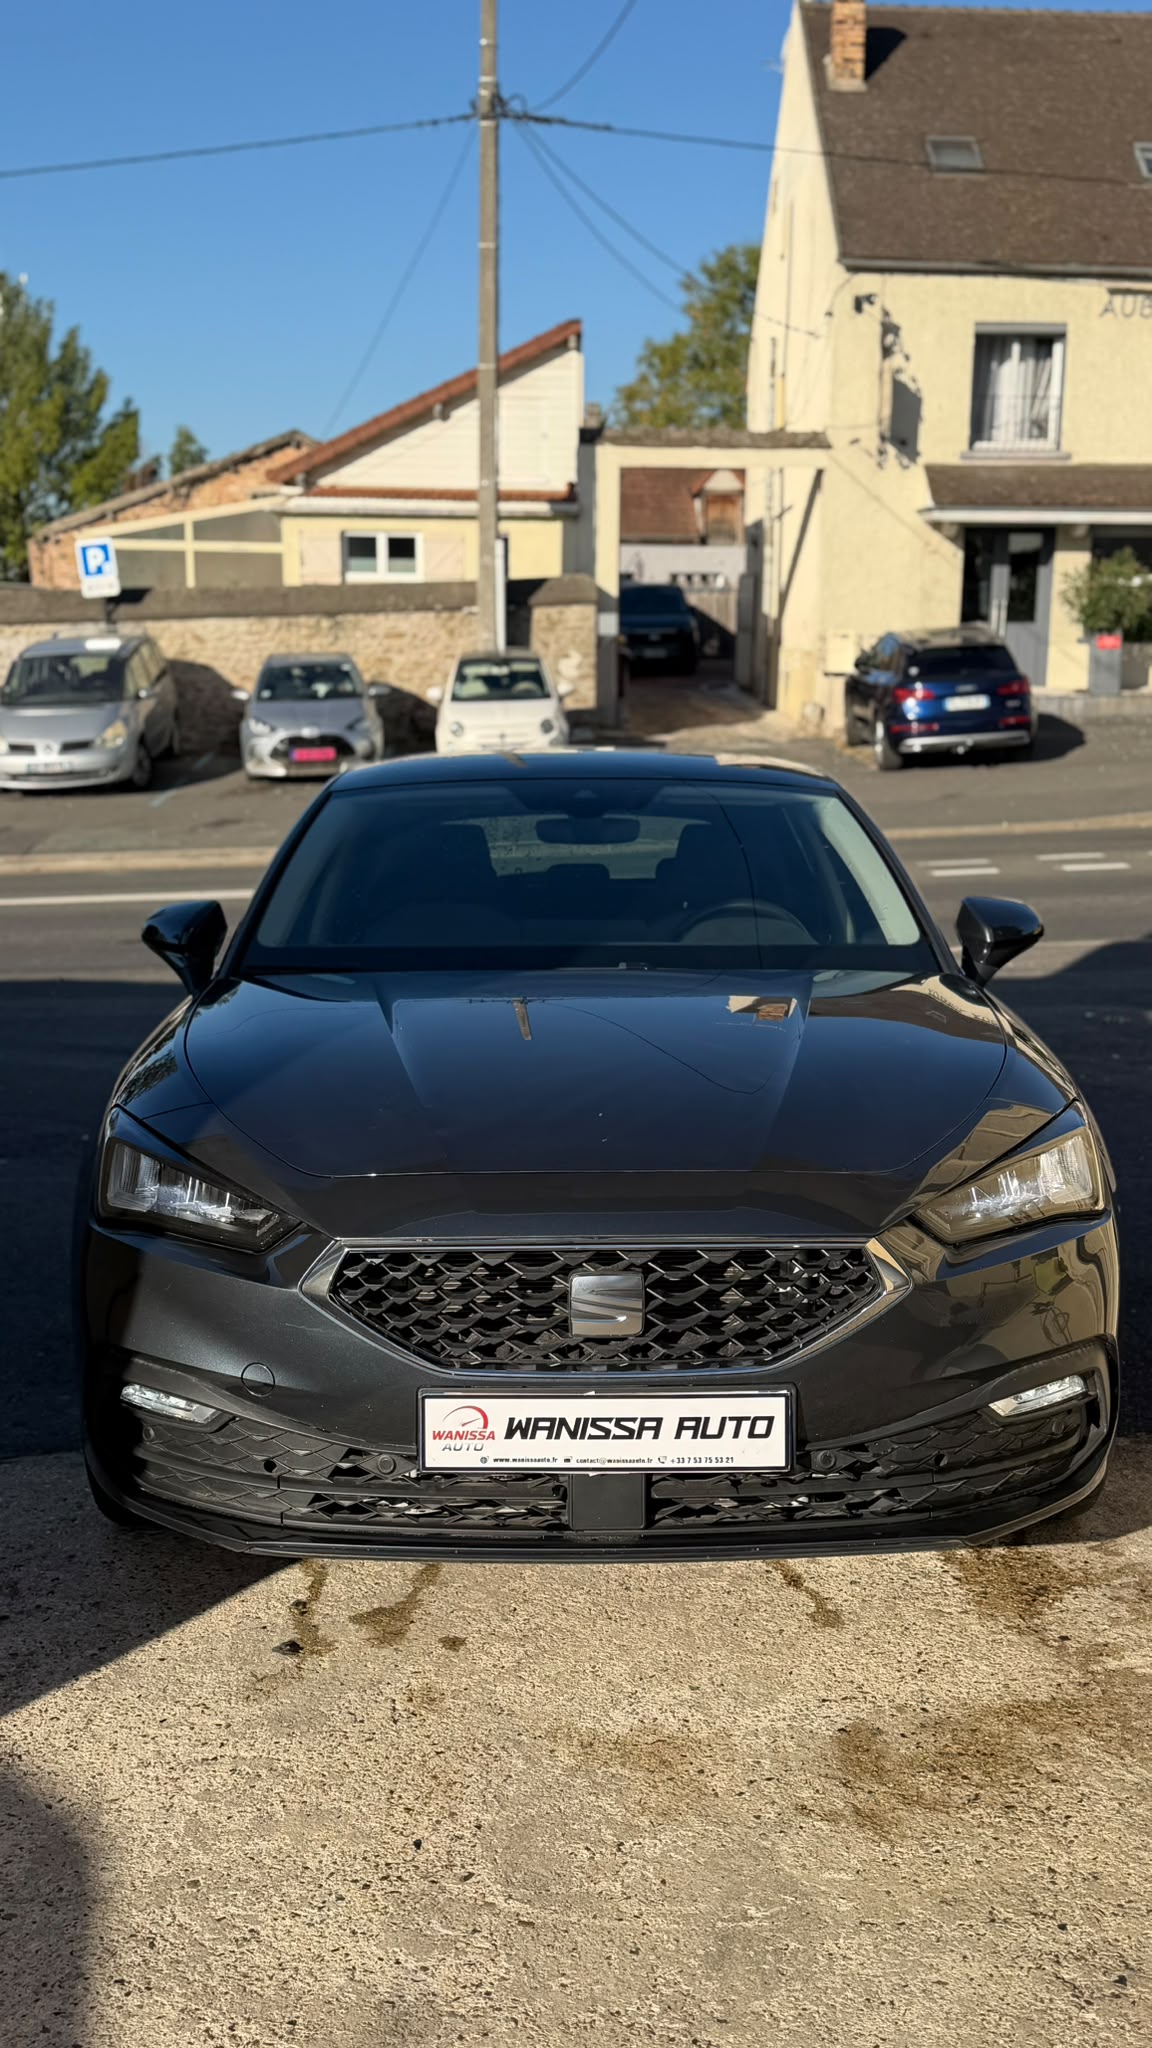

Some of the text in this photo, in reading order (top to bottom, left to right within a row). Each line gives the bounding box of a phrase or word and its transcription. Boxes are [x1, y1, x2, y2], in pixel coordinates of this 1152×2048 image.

[85, 547, 106, 575] P
[503, 1416, 775, 1440] WANISSA AUTO
[432, 1430, 496, 1441] WANISSA
[441, 1442, 484, 1452] AUTO
[670, 1456, 685, 1464] +33
[704, 1456, 713, 1464] 75
[714, 1456, 724, 1464] 53
[725, 1456, 734, 1464] 21
